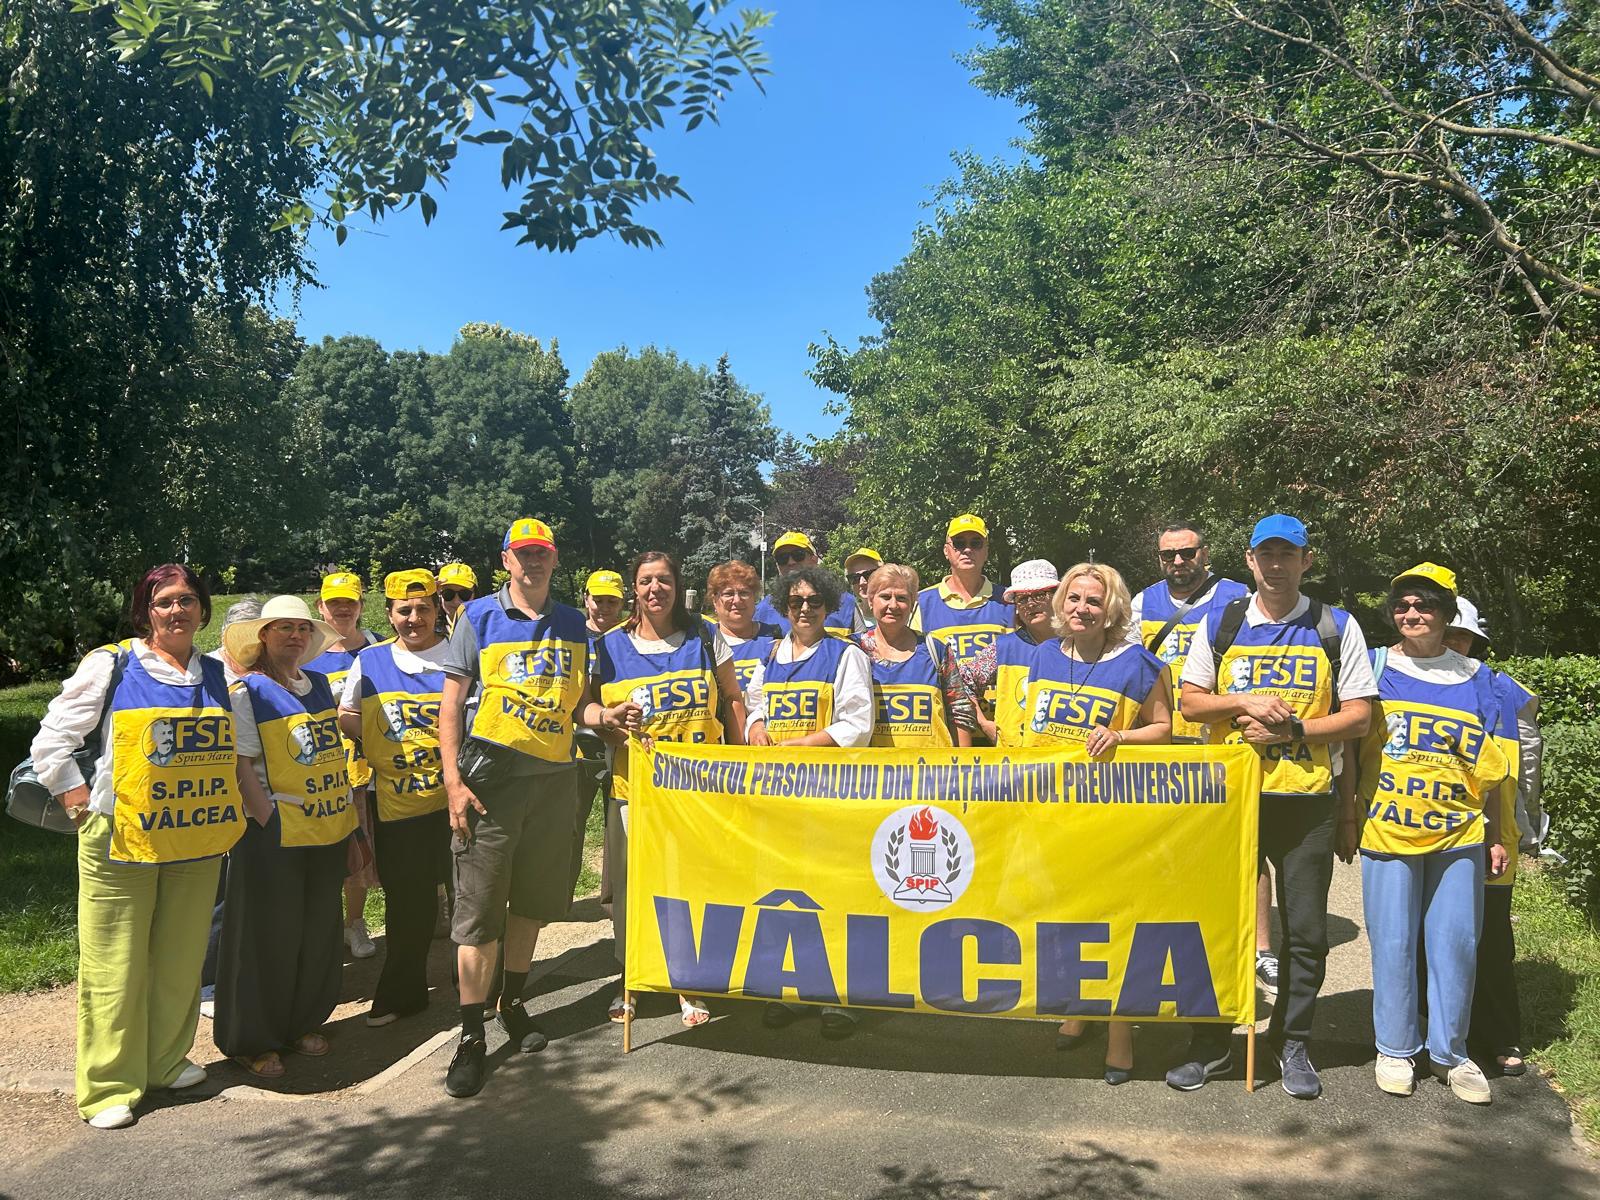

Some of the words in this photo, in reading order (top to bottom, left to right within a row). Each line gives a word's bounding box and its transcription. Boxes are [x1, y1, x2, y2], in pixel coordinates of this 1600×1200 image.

[526, 650, 571, 676] FSE
[1252, 658, 1315, 686] FSE
[652, 680, 708, 710] FSE
[769, 691, 816, 718] FSE
[874, 694, 930, 721] FSE
[402, 702, 441, 728] FS
[502, 695, 564, 735] VÂLCE
[656, 711, 682, 723] Spiru
[1048, 692, 1114, 727] FSE
[176, 719, 233, 749] FSE
[310, 720, 341, 748] FS
[790, 719, 816, 728] Haret
[876, 724, 899, 734] Spiru
[902, 723, 930, 733] Haret
[1049, 722, 1076, 737] Spiru
[1409, 715, 1483, 761] FSE
[175, 753, 205, 765] Spiru
[207, 751, 232, 761] Hare
[1408, 750, 1443, 763] Spiru
[152, 777, 228, 801] S.P.I.P.
[652, 751, 748, 796] SINDICATUL
[749, 762, 879, 801] PERSONALULUI
[881, 764, 915, 801] DIN
[917, 756, 1059, 815] ÎNVĂȚĂMÂNTUL
[1063, 761, 1227, 805] PREUNIVERSITAR
[138, 805, 237, 831] VÂLCEA
[299, 796, 350, 819] VÂLC
[905, 877, 939, 890] SPIP
[653, 888, 1222, 1018] VÂLCEA
